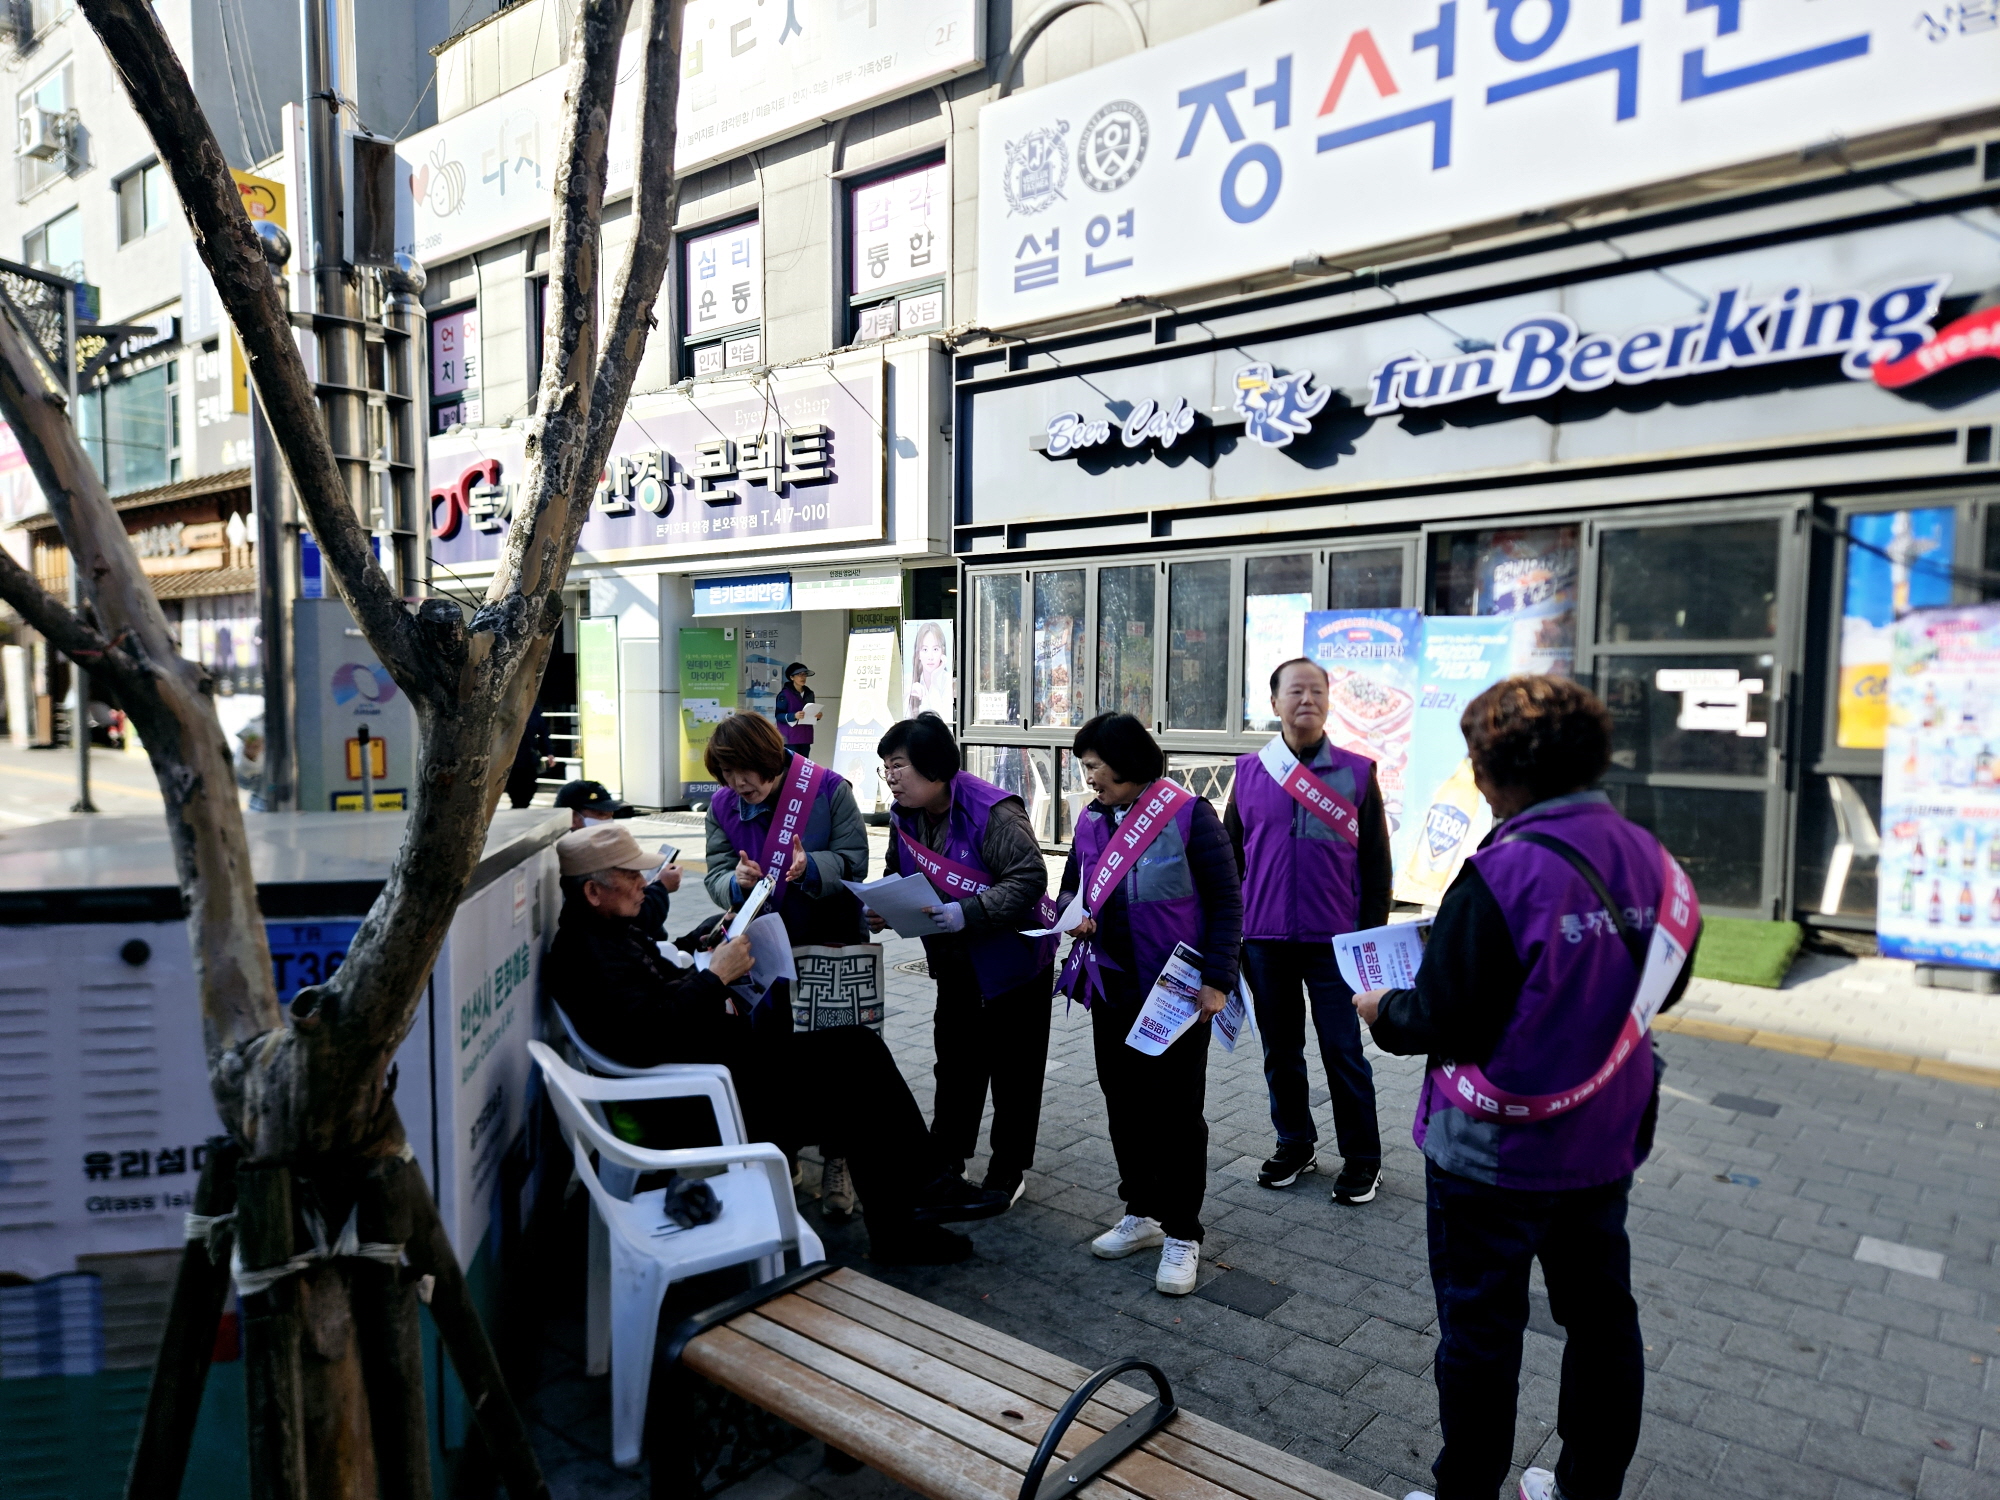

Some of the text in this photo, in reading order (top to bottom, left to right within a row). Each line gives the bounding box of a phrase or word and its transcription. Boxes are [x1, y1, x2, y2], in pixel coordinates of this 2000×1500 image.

[934, 21, 958, 46] 2F
[867, 186, 934, 232] 감각
[698, 237, 750, 280] 심리
[867, 230, 935, 279] 통합
[698, 280, 751, 323] 운동
[906, 300, 937, 325] 상담
[441, 320, 476, 353] 언어
[442, 356, 477, 385] 치료
[698, 342, 755, 373] 인지 학습
[735, 396, 831, 430] Eyewear Shop
[1047, 395, 1195, 456] Beer Cafe
[655, 503, 831, 539] 돈키호테 안경 본오직영점 T.417-0101
[708, 582, 785, 605] 돈키호테안경
[686, 660, 732, 670] 원데이 렌즈
[690, 671, 726, 682] 마이데이
[1295, 776, 1348, 821] 대한민국
[778, 798, 803, 845] 이민청
[1427, 808, 1468, 843] TERRA
[1090, 786, 1178, 903] 대한민국 이민청
[1362, 941, 1385, 986] 서명운동
[1141, 1015, 1172, 1038] 서명운동
[85, 1190, 192, 1214] Glass Isl
